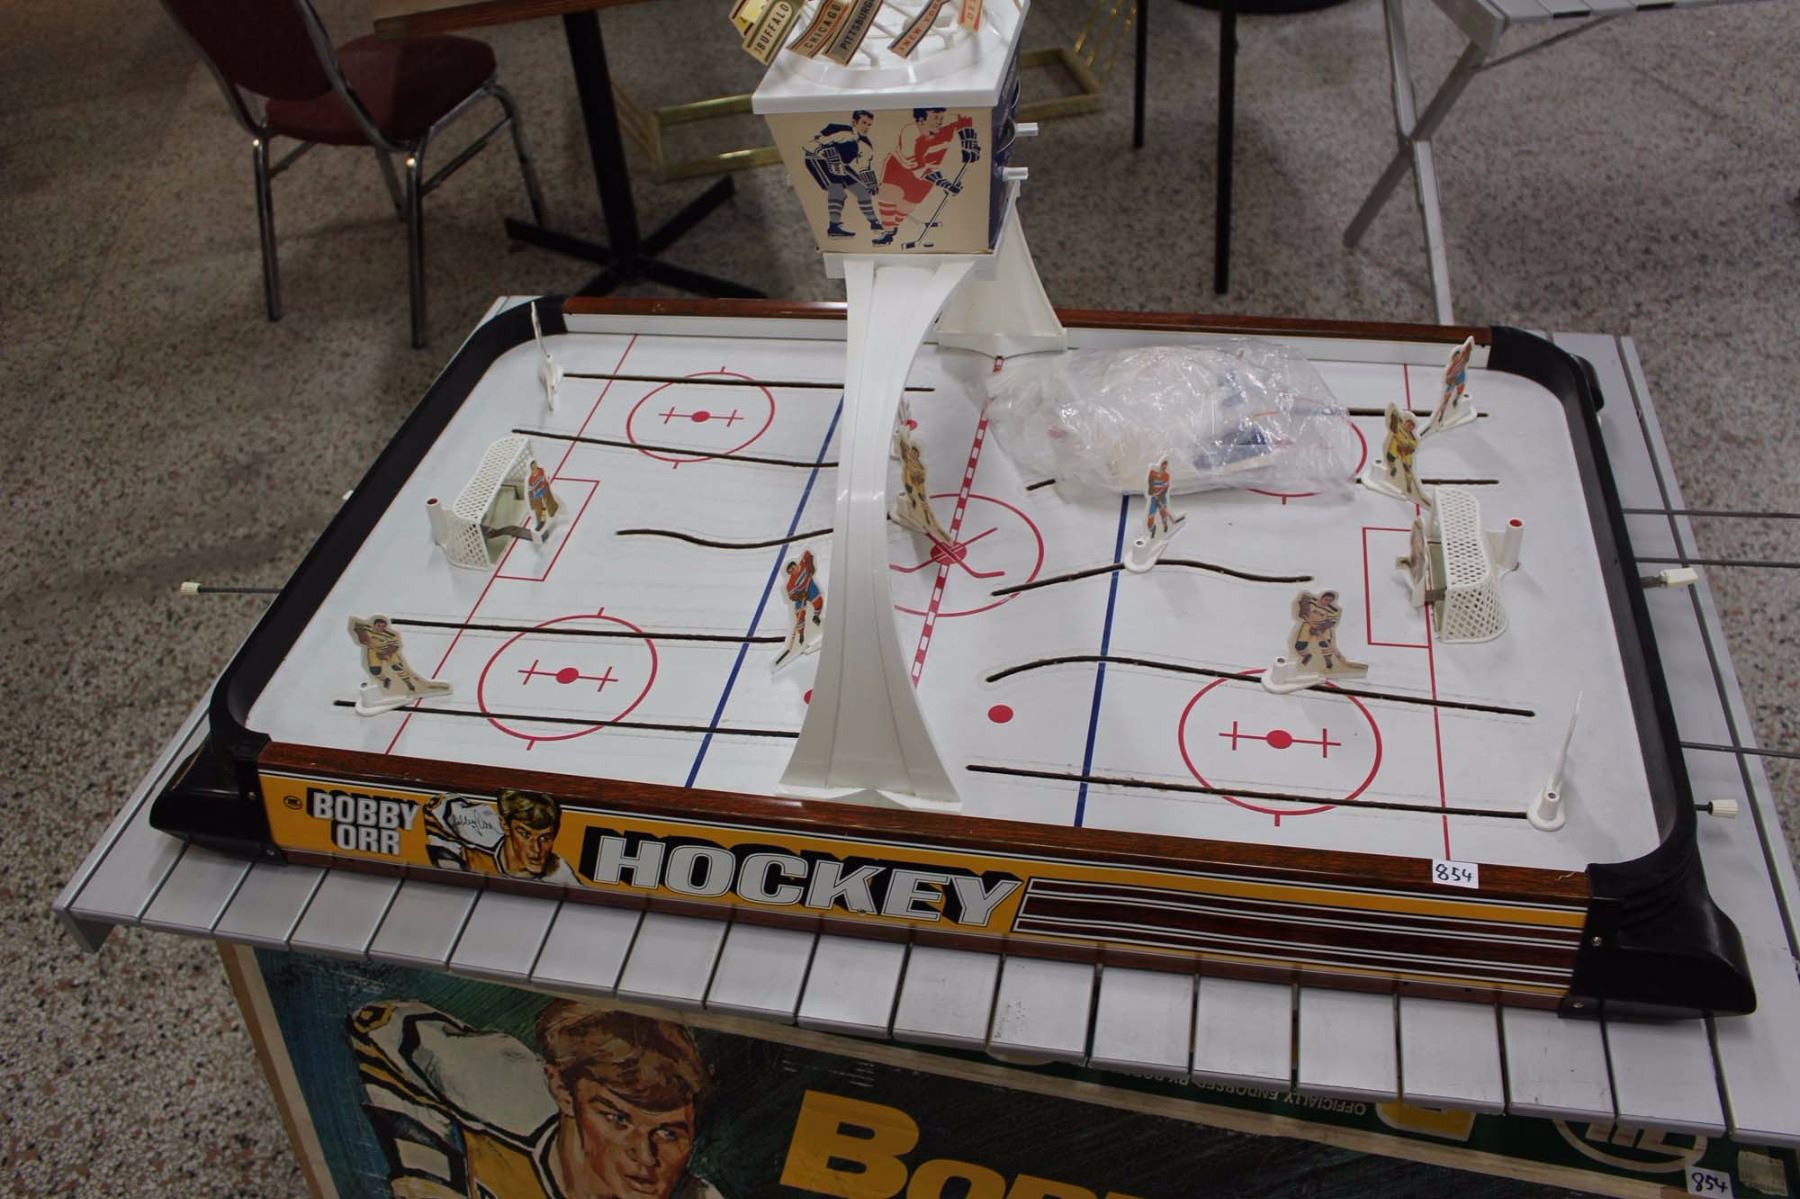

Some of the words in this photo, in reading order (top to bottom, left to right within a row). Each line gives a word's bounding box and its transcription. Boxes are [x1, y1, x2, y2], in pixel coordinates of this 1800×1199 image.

[756, 3, 789, 50] BUFFALO
[804, 4, 840, 48] CHICAGO
[840, 0, 874, 49] PITTSBURG
[307, 788, 419, 830] BOBBY
[332, 822, 400, 855] ORR
[582, 828, 1022, 927] HOCKEY
[1436, 863, 1472, 882] 854
[1691, 1172, 1728, 1193] 854
